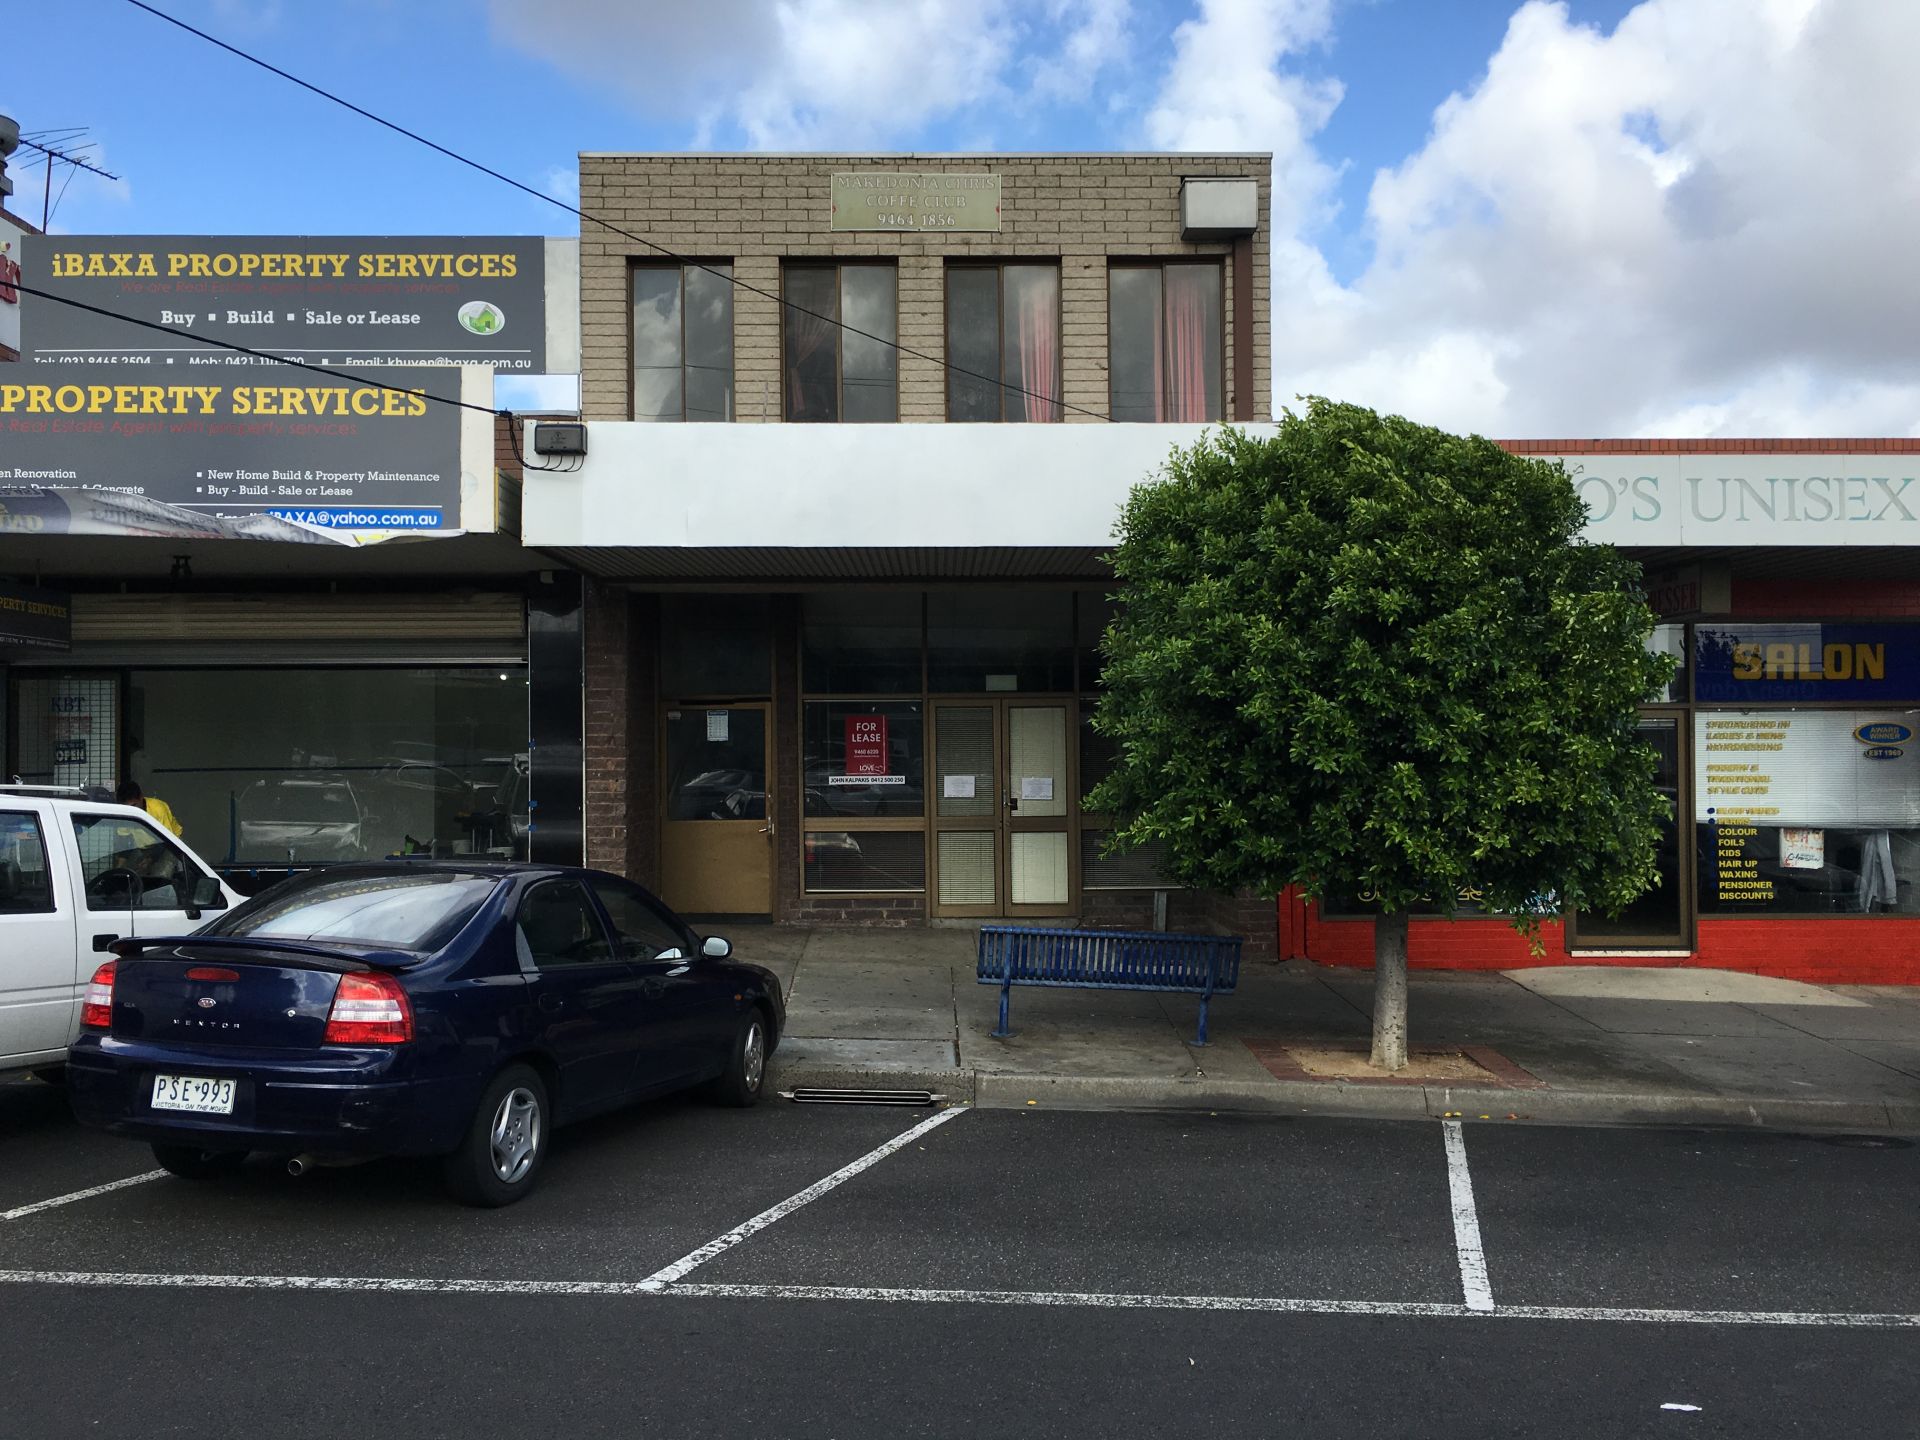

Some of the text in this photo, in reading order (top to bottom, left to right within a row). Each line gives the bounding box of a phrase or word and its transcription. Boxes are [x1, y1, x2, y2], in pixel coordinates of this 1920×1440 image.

[837, 175, 996, 190] MAKEDONIA CHRIS
[866, 194, 967, 208] COFFE CLUB
[877, 213, 956, 226] 9464 1856
[52, 253, 518, 277] iBAXA PROPERTY SERVICES
[161, 310, 421, 327] Buy Build Sale or Lease
[0, 384, 427, 416] PROPERTY SERVICES
[14, 468, 77, 479] Renovation
[207, 470, 441, 483] New Home Build & Property Maintenance
[207, 485, 230, 498] Buy
[239, 485, 269, 496] Build
[278, 485, 303, 496] Sale
[305, 488, 319, 496] or
[320, 486, 353, 497] Lease
[1573, 475, 1918, 523] O'S UNISEX
[270, 511, 438, 527] BAXA@yahoo.com.au
[1732, 643, 1885, 681] SALON
[856, 722, 877, 732] FOR
[1870, 726, 1901, 734] AWARD
[851, 733, 881, 743] LEASE
[1718, 828, 1758, 836] COLOUR
[1718, 838, 1745, 847] FOILS
[1718, 849, 1741, 857] KIDS
[1718, 860, 1758, 868] HAIR UP
[1719, 870, 1758, 878] WAXING
[1719, 881, 1773, 889] PENSIONER
[1719, 892, 1774, 900] DISCOUNTS
[173, 1018, 241, 1029] MENTOR
[156, 1078, 231, 1104] PSE 993
[155, 1101, 181, 1109] VICTORIA
[209, 1105, 228, 1113] MOVE
